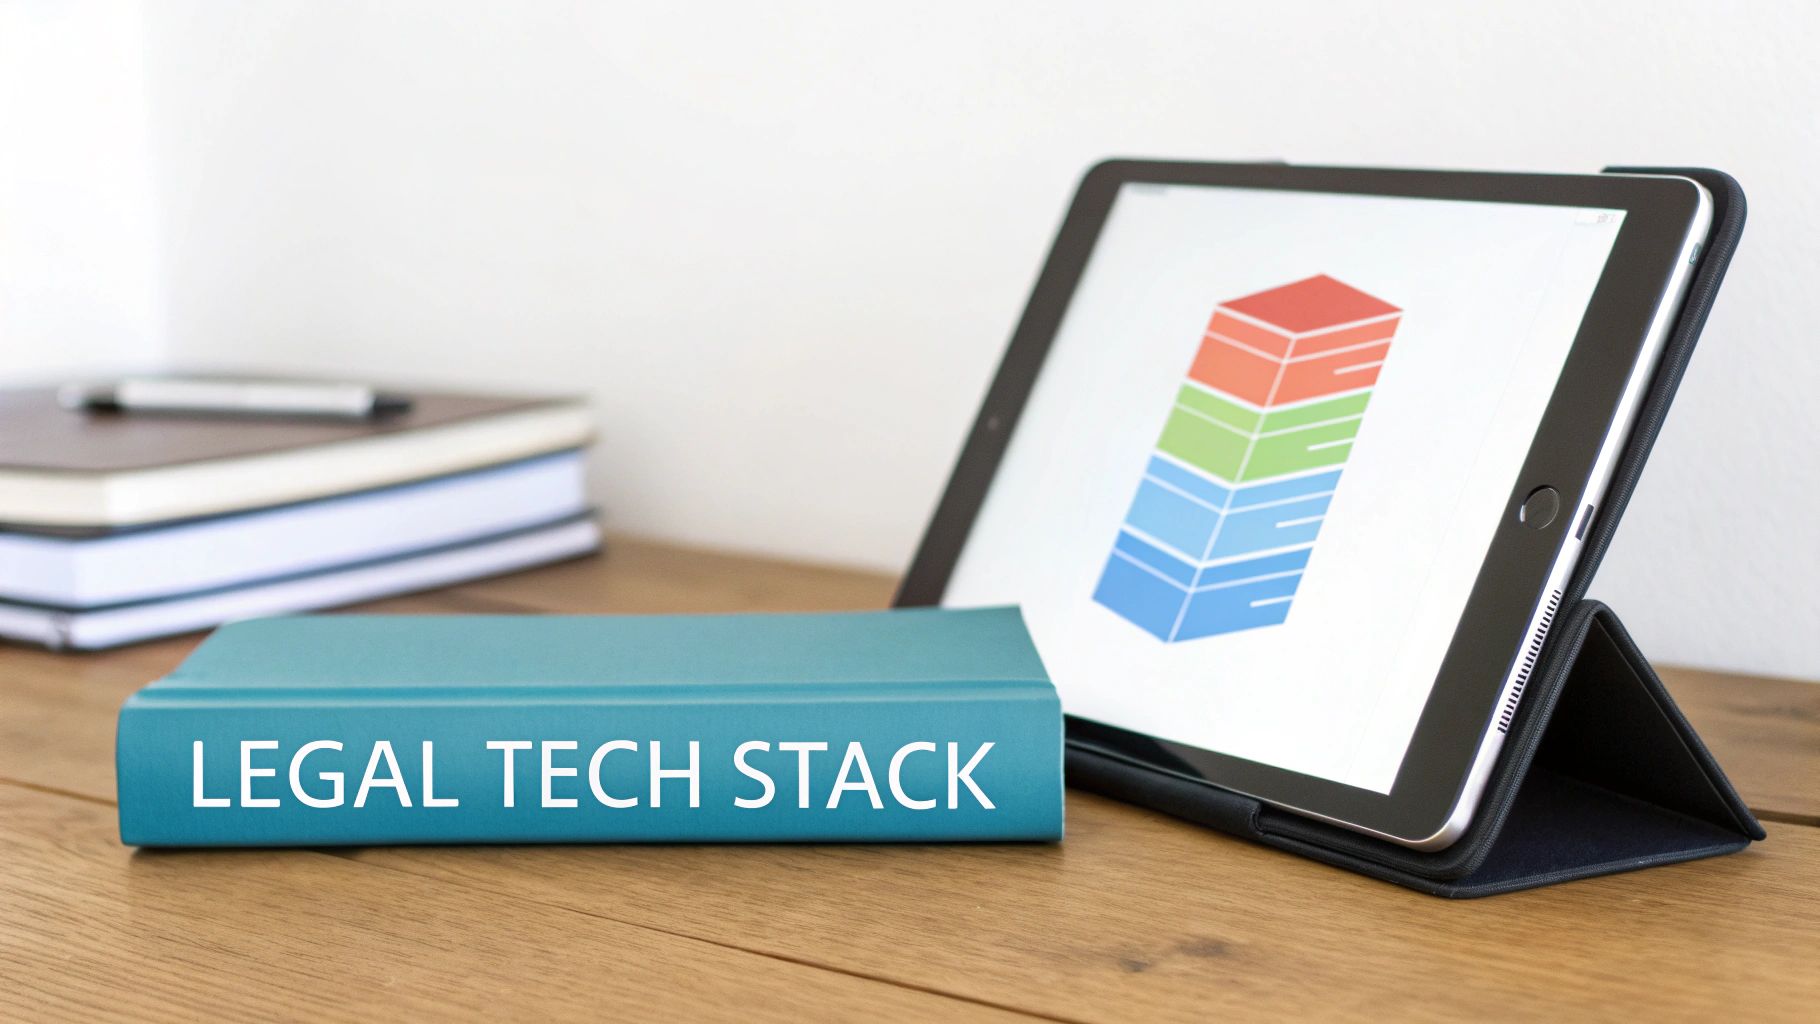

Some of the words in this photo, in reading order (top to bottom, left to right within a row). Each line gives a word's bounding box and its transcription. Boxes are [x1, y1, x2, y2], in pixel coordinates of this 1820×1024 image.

[192, 739, 459, 809] LEGAL
[486, 739, 700, 809] TECH
[733, 740, 997, 811] STACK
